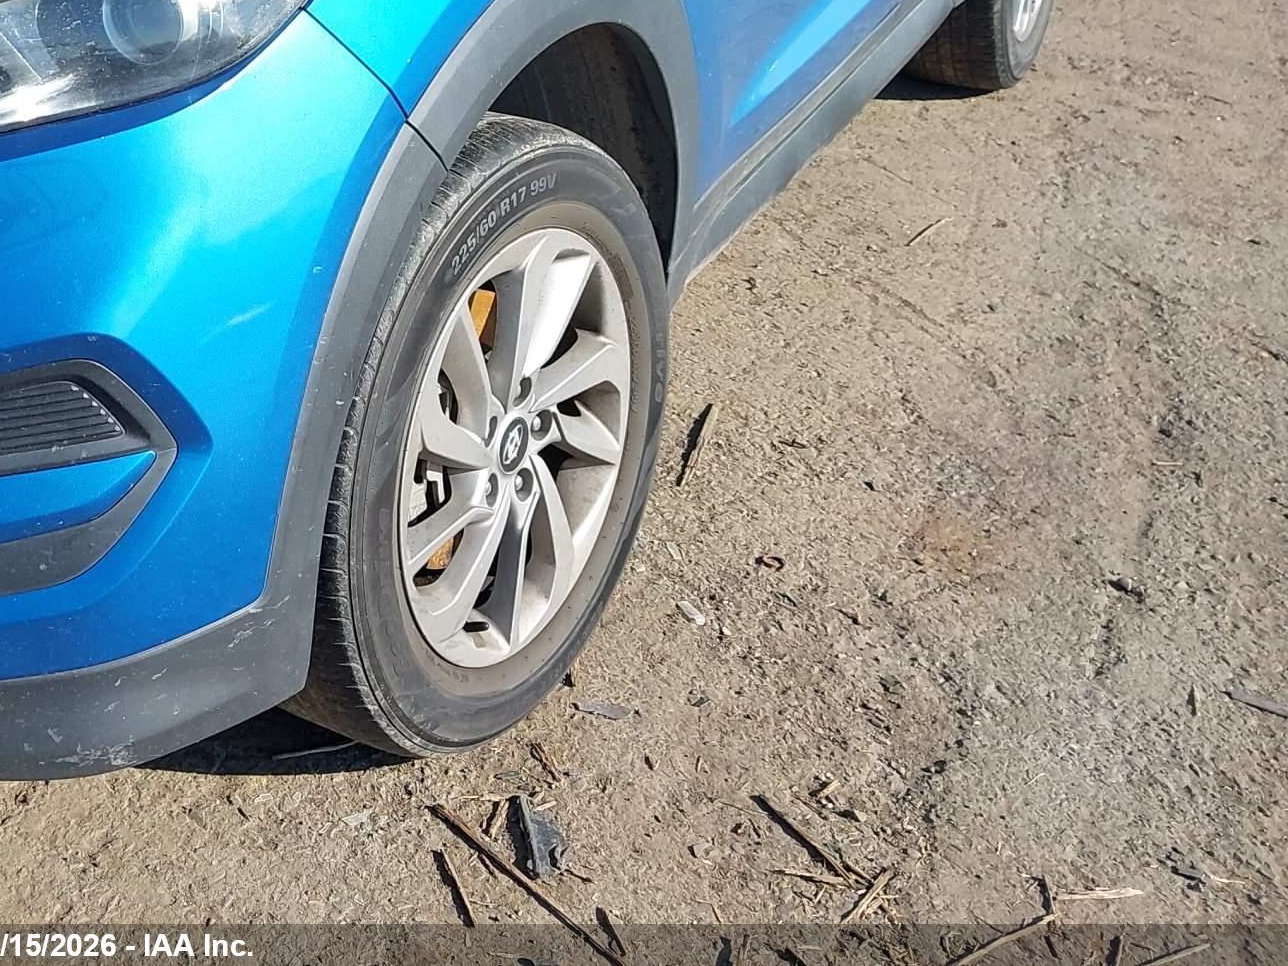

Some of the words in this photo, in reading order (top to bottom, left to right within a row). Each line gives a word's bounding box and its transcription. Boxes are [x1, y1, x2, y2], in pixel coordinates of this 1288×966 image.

[452, 210, 497, 275] 225/60
[500, 186, 527, 217] R17
[530, 173, 557, 196] 99V
